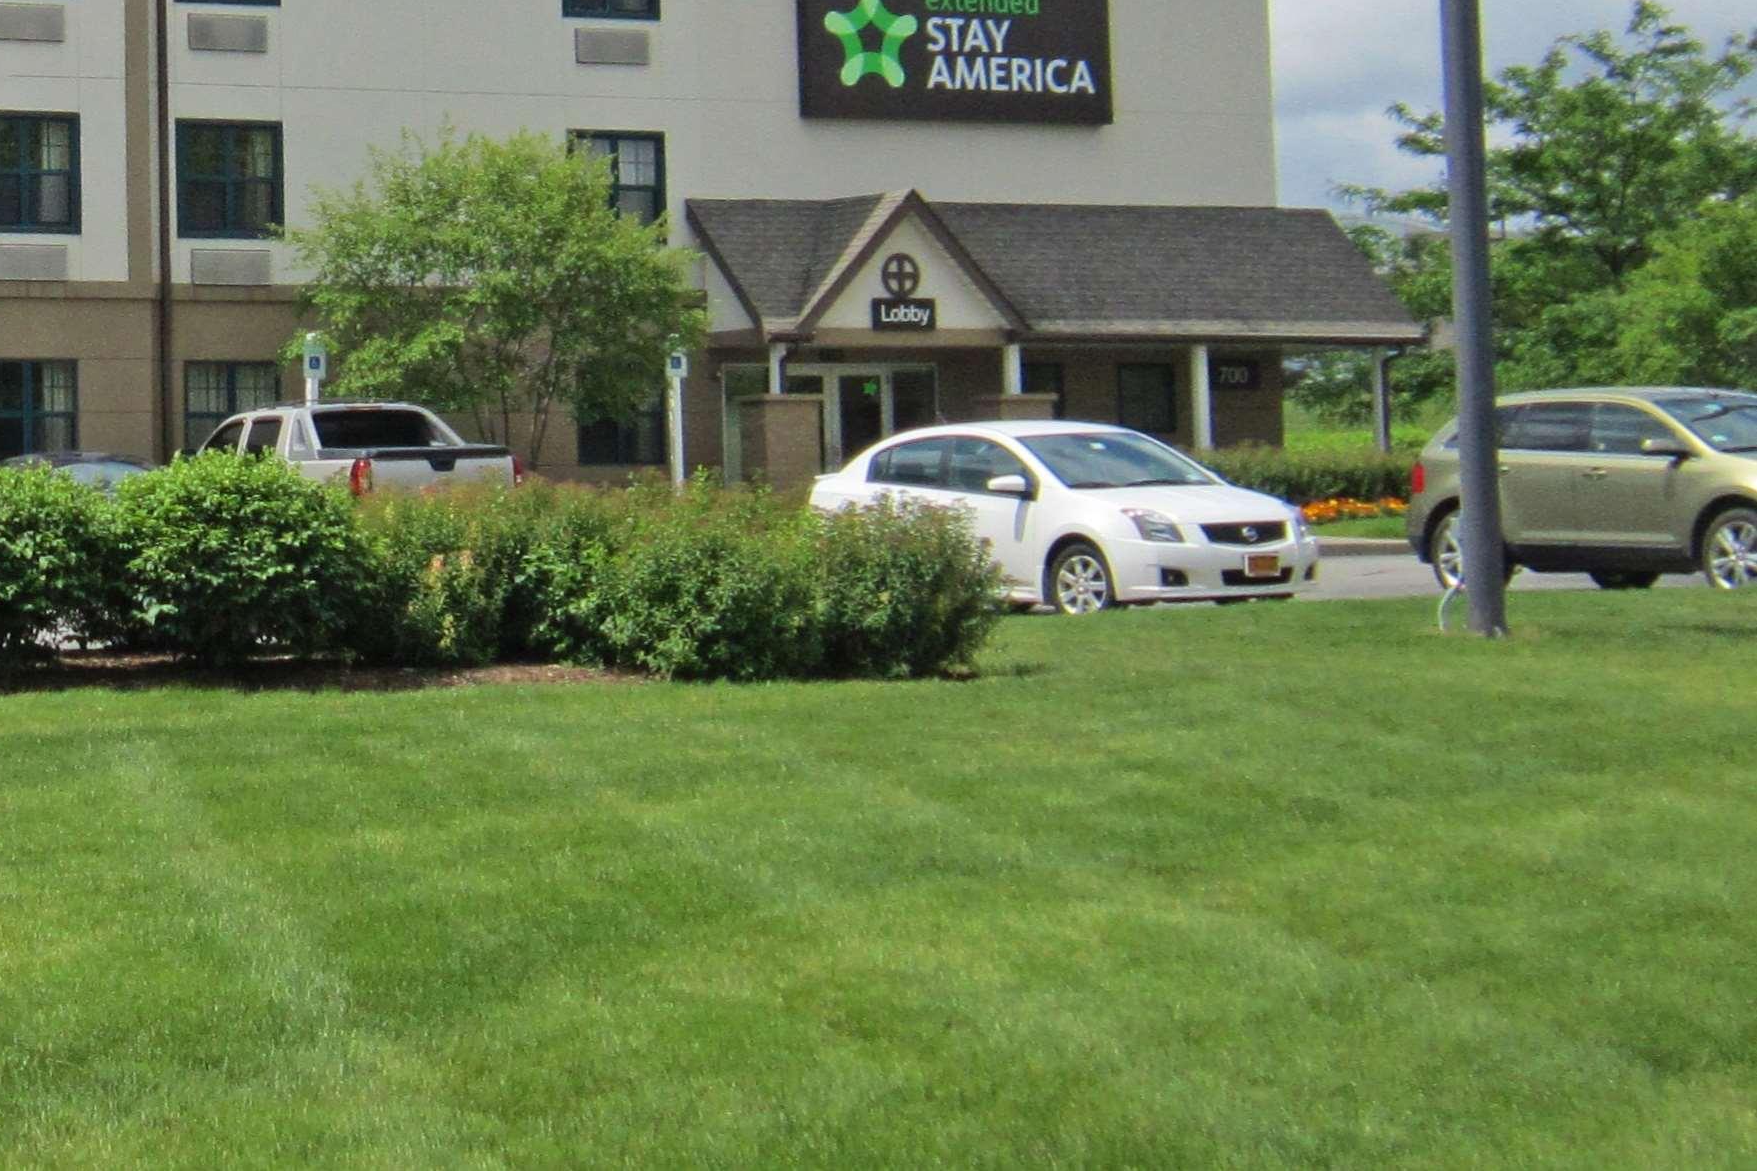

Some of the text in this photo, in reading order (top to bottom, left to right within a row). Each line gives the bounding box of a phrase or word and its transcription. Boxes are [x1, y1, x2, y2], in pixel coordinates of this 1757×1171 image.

[926, 17, 1012, 53] STAY
[926, 56, 1095, 94] AMERICA
[880, 304, 930, 326] Lobby
[1219, 366, 1249, 383] 700
